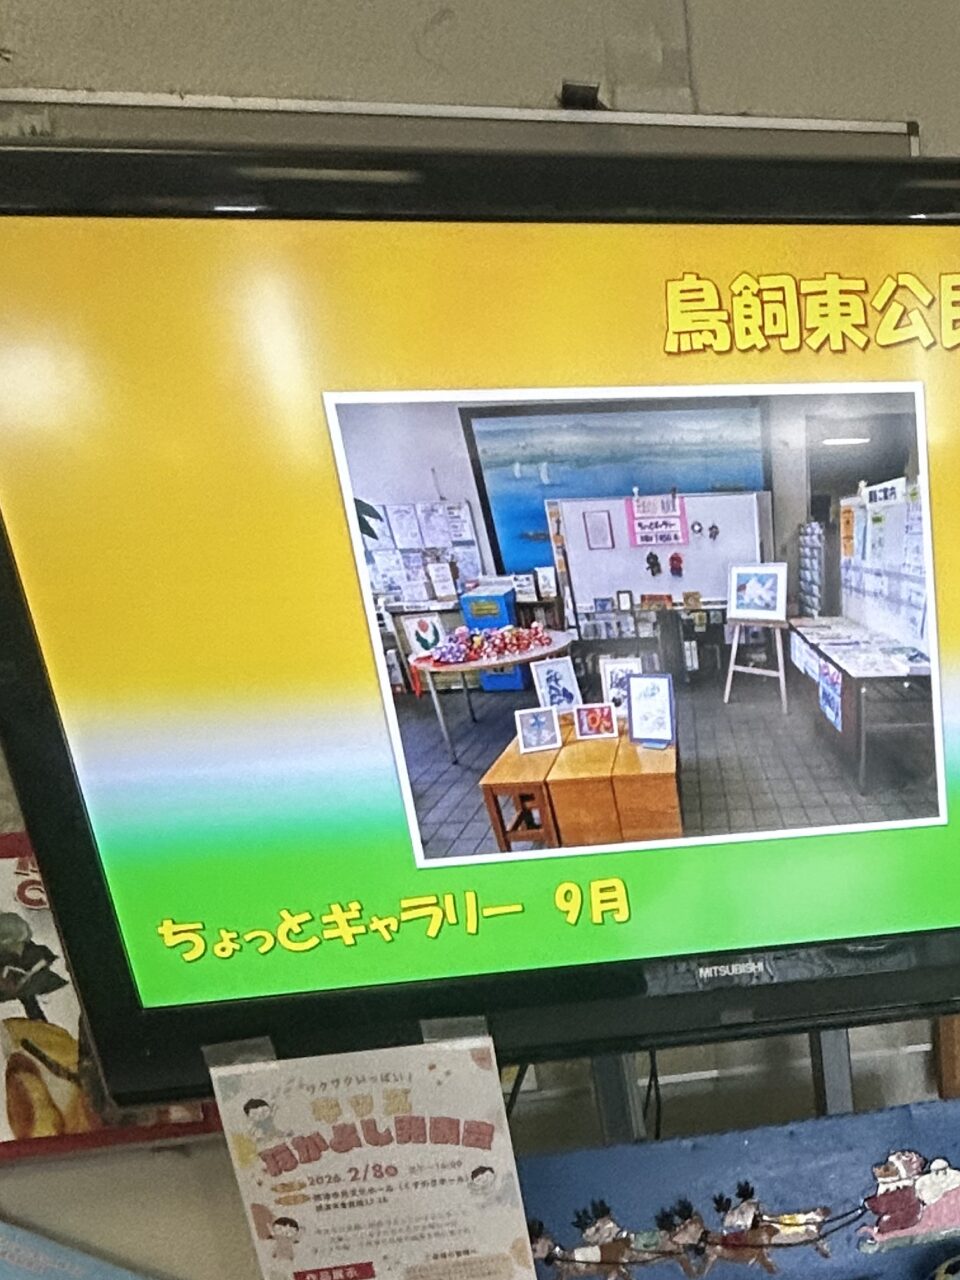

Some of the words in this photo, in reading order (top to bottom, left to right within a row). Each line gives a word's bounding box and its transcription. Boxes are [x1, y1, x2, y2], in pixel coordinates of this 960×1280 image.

[156, 890, 523, 963] ちょっとギャラリー
[553, 877, 631, 926] 9月
[698, 961, 764, 979] MITSUBISHI
